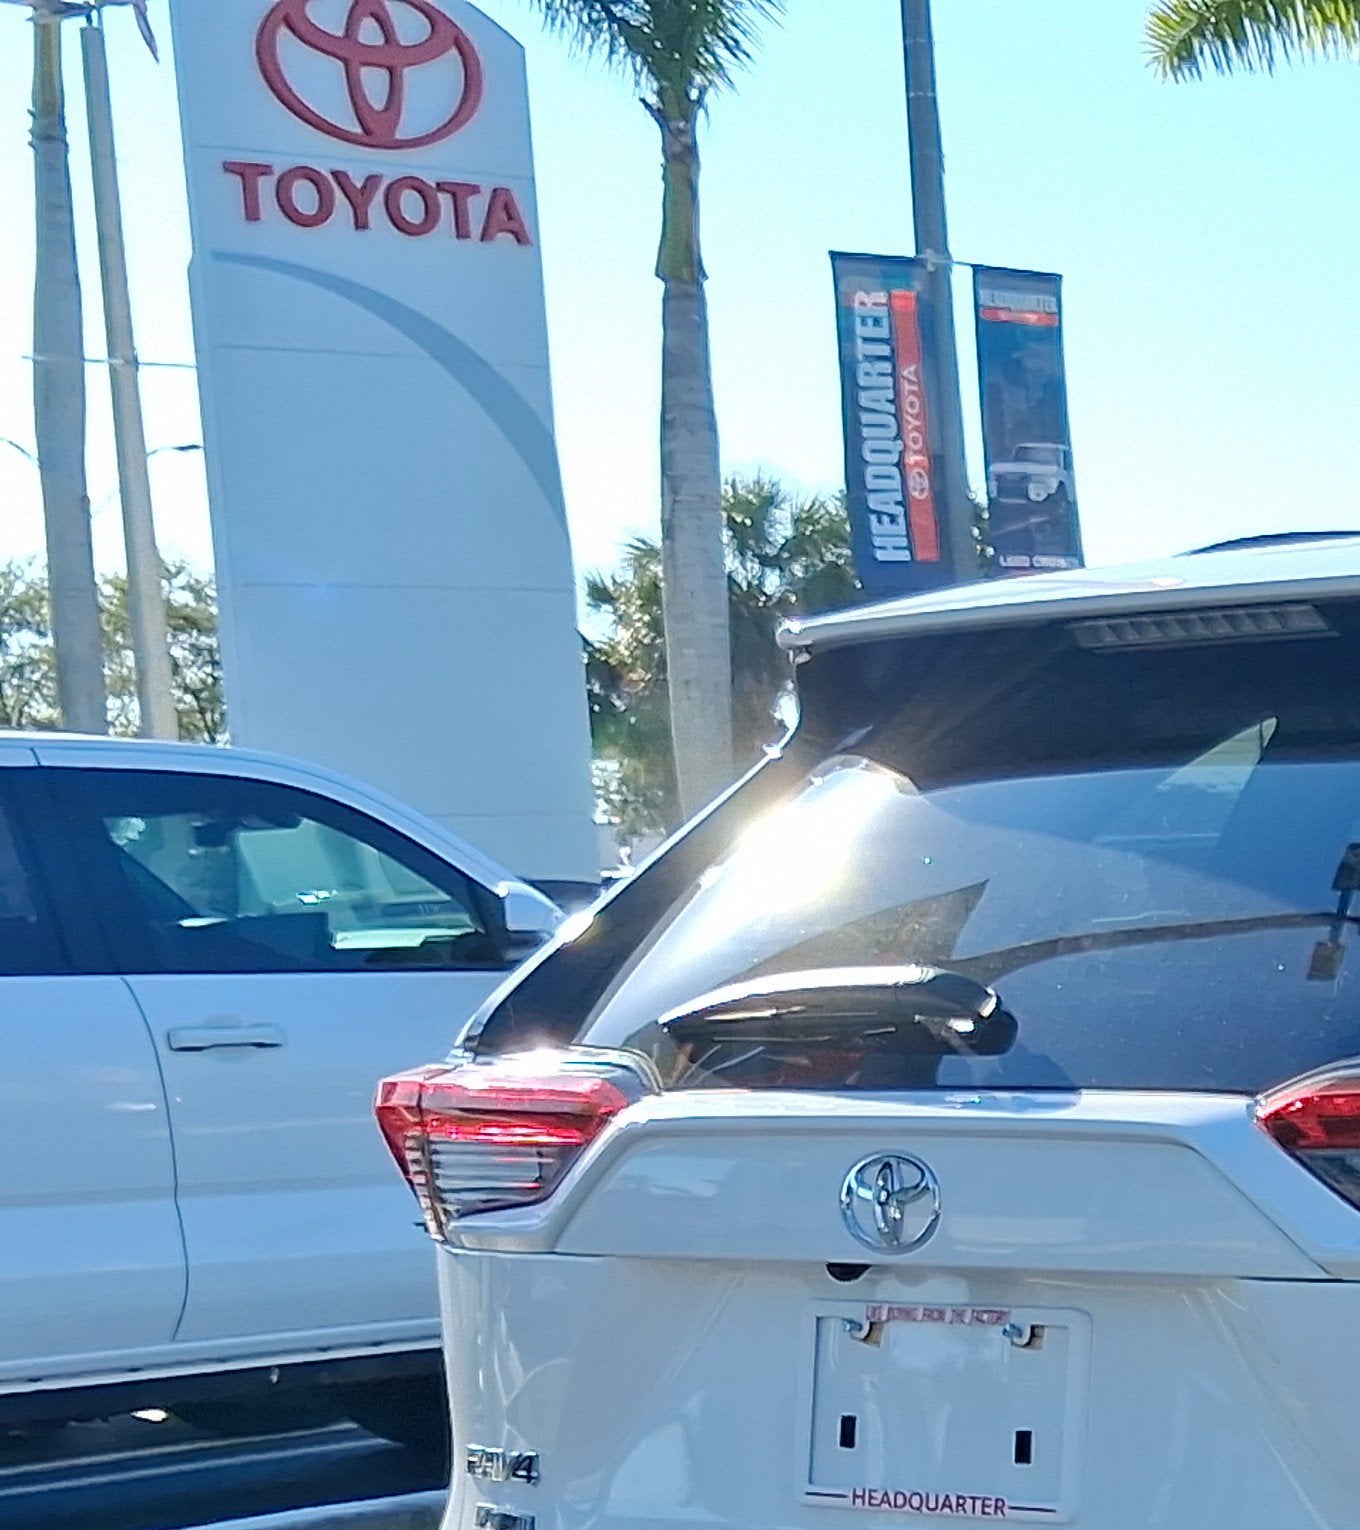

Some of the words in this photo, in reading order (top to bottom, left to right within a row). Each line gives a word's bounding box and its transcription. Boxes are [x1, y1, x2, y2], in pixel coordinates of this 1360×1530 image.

[222, 160, 532, 246] TOYOTA
[854, 290, 911, 562] HEADQUARTER
[900, 364, 930, 464] TOYOTA
[852, 1487, 1007, 1517] HEADQUARTER
